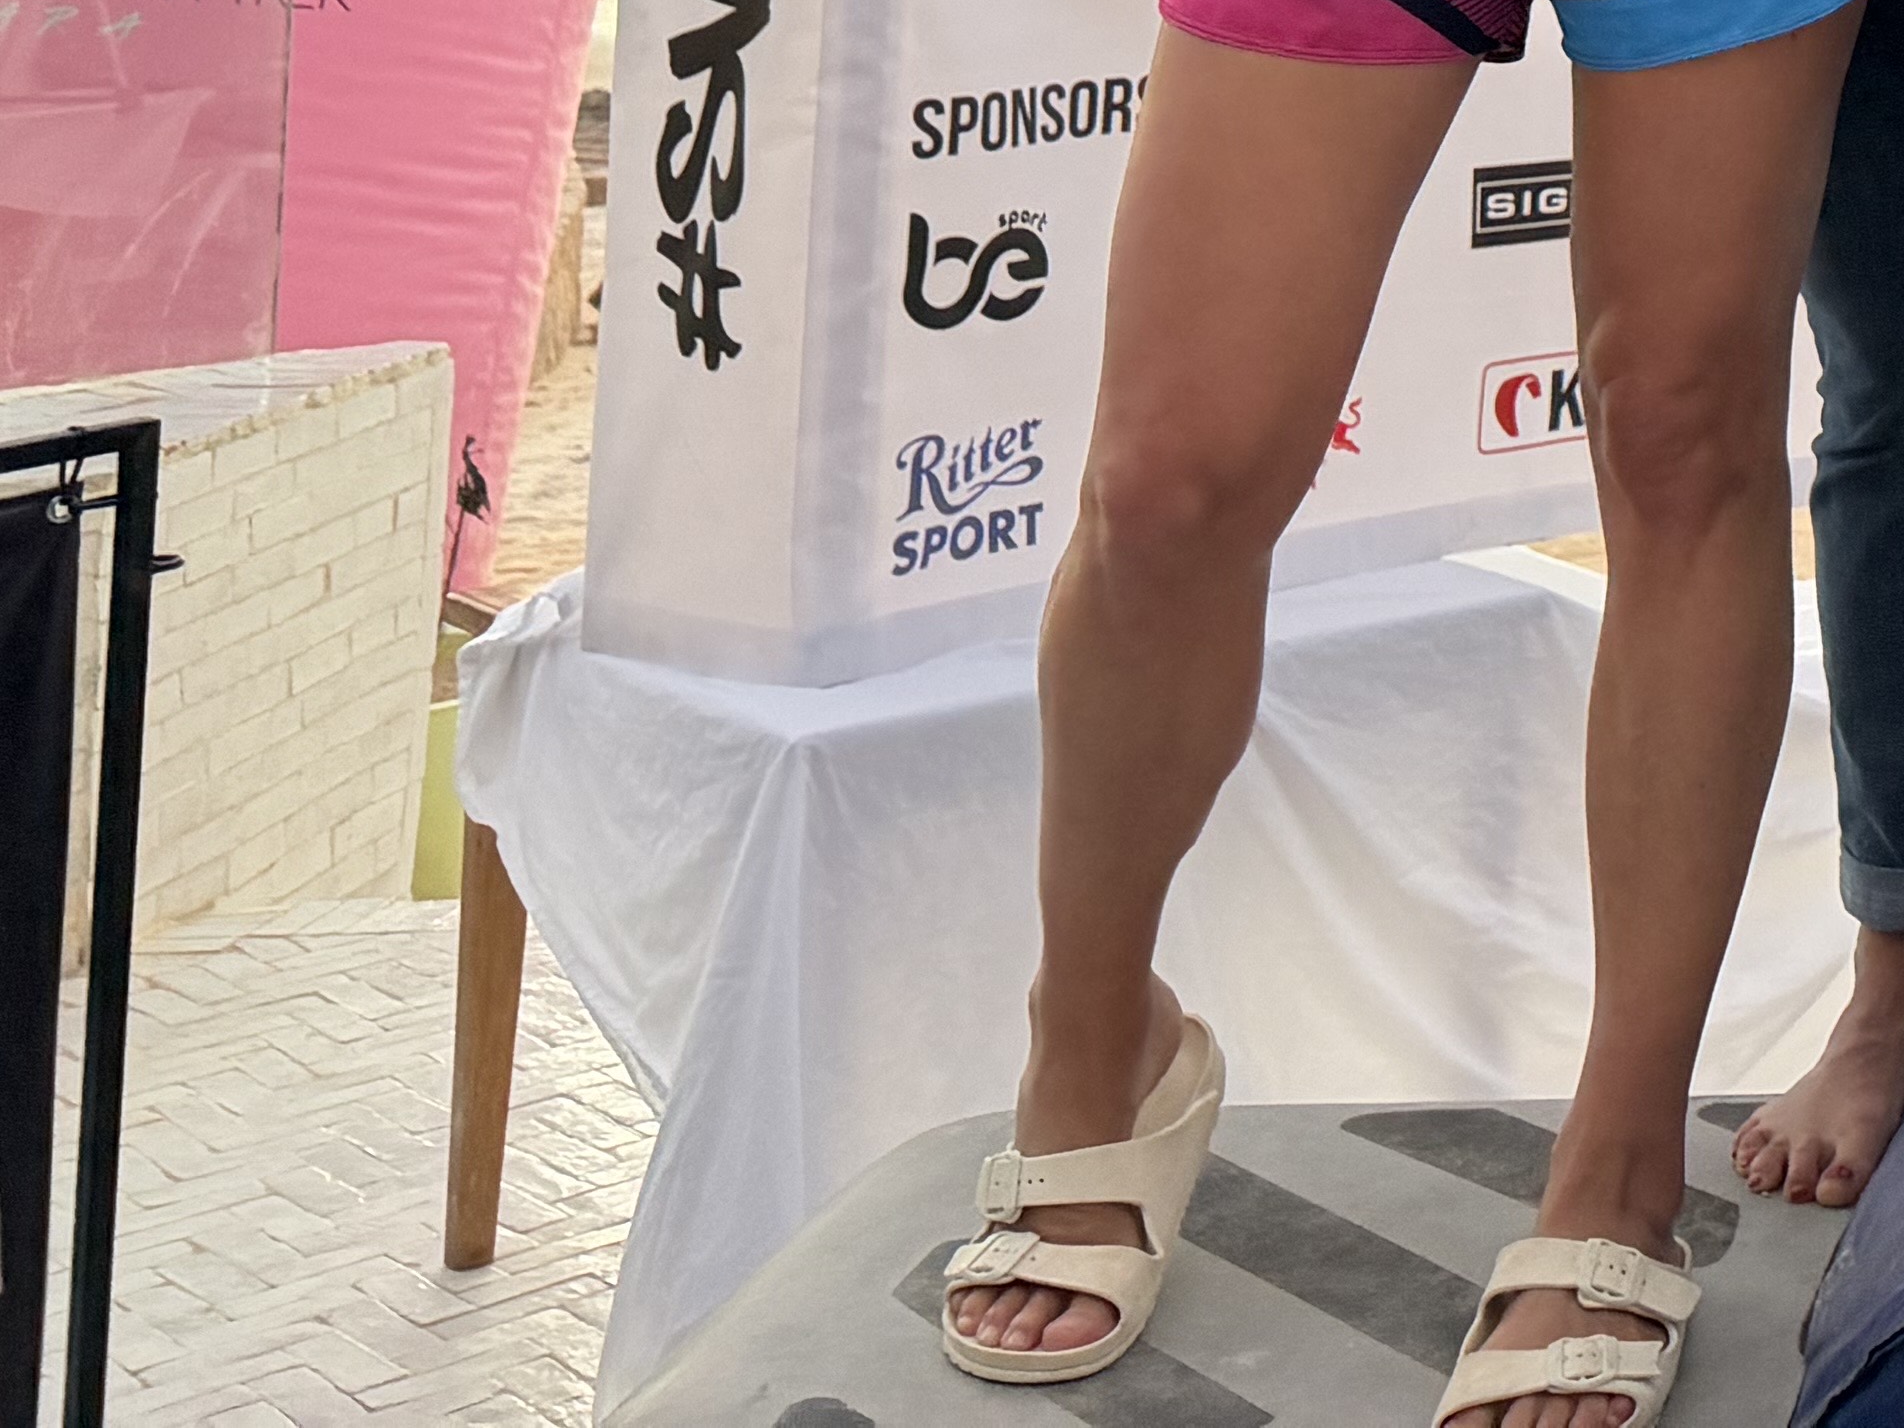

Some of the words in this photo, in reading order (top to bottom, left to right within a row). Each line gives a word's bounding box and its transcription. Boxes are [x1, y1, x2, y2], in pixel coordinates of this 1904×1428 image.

[912, 75, 1146, 160] SPONSOR
[998, 209, 1048, 232] sport
[896, 417, 1044, 521] Ritter
[891, 501, 1044, 576] SPORT
